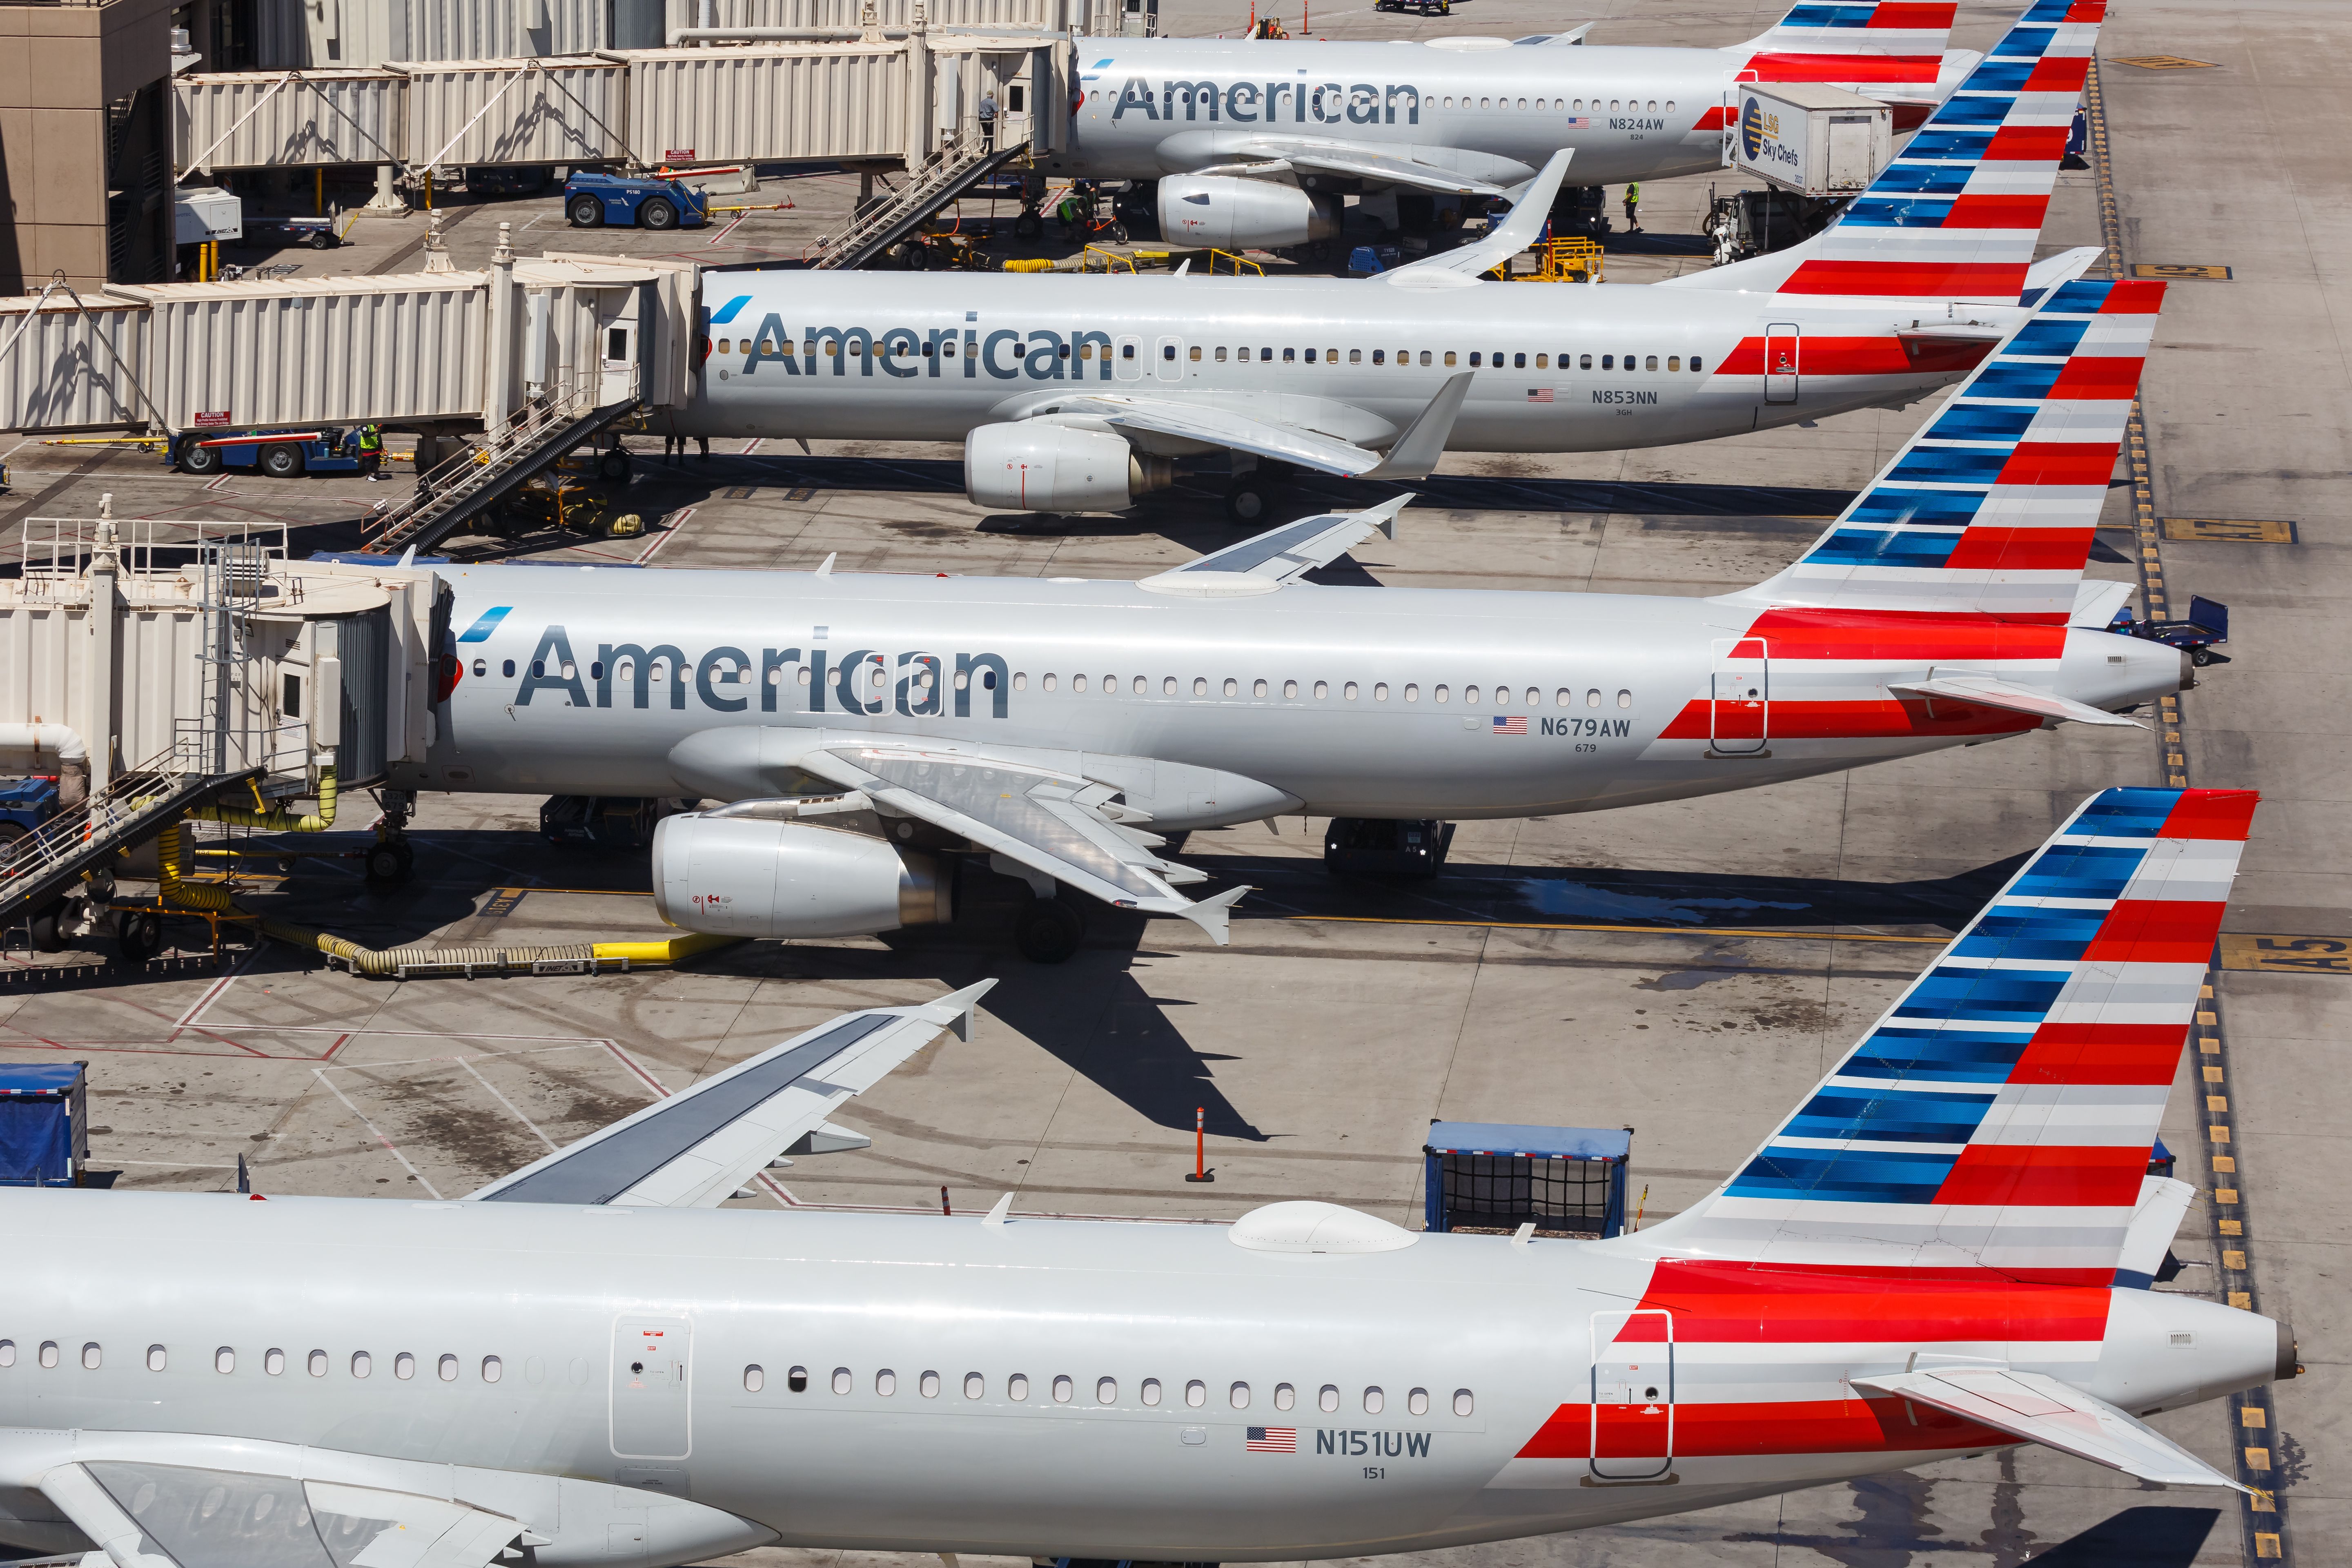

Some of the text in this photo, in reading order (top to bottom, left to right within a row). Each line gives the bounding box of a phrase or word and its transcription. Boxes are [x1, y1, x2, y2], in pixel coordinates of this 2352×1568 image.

[1112, 69, 1419, 125] American
[1609, 118, 1664, 130] N824AW
[1763, 111, 1779, 134] LSG
[1763, 138, 1798, 167] Sky Chefs
[2154, 266, 2209, 278] A9
[742, 312, 1112, 380] American
[1592, 390, 1657, 404] N853NN
[2194, 521, 2263, 540] A7
[514, 625, 1008, 719] American
[1541, 717, 1630, 737] N679AW
[1575, 744, 1596, 752] 679
[383, 792, 404, 801] A320
[385, 802, 404, 810] 679
[2256, 938, 2350, 971] A5
[1317, 1429, 1432, 1457] N151UW
[1363, 1467, 1385, 1479] 151
